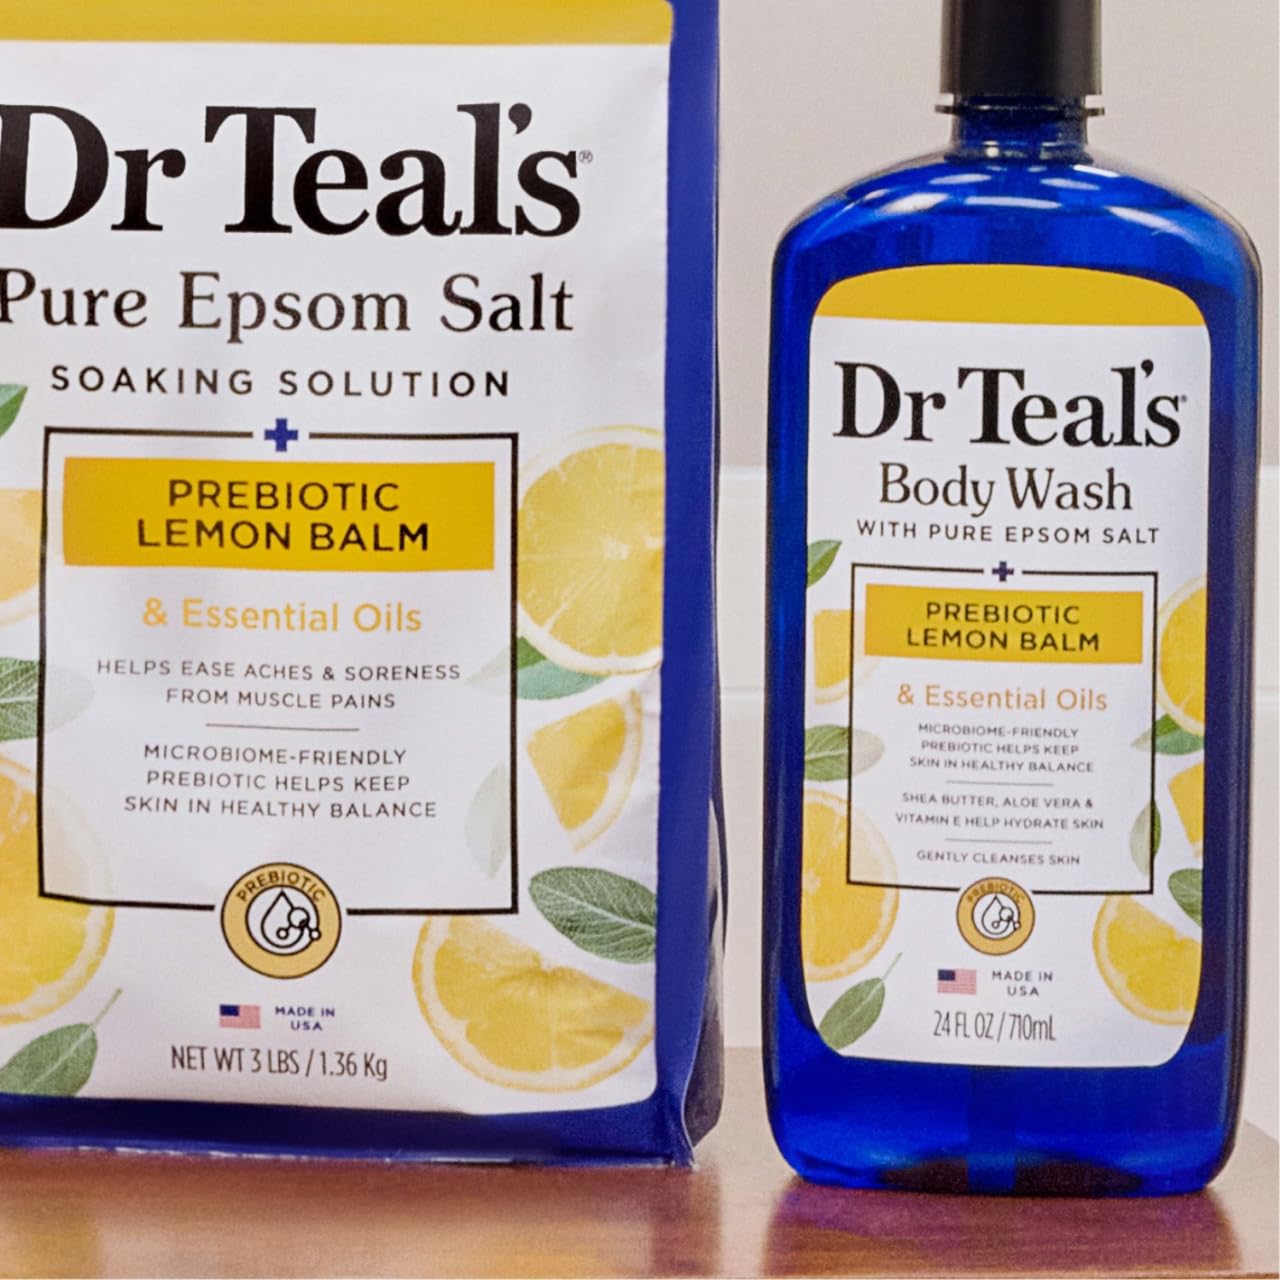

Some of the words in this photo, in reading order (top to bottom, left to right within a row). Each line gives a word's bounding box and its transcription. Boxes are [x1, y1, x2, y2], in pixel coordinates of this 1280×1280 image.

[204, 102, 581, 237] Teal's
[178, 270, 411, 344] Epsom
[440, 272, 574, 333] Salt
[51, 365, 253, 395] SOAKING
[279, 370, 509, 397] SOLUTION
[832, 361, 946, 442] Dr
[957, 359, 1181, 448] Teal's
[169, 479, 399, 512] PREBIOTIC
[879, 462, 995, 518] Body
[1005, 467, 1132, 511] Wash
[137, 518, 291, 550] LEMON
[310, 522, 428, 552] BALM
[857, 520, 917, 538] WITH
[929, 523, 992, 542] PURE
[1006, 526, 1089, 543] EPSOM
[1102, 527, 1159, 545] SALT
[142, 597, 167, 627] &
[183, 599, 339, 633] Essential
[353, 602, 421, 633] Oils
[927, 602, 1080, 625] PREBIOTIC
[907, 627, 1008, 649] LEMON
[1020, 632, 1099, 652] BALM
[97, 659, 171, 676] HELPS
[181, 661, 235, 678] EASE
[244, 664, 313, 681] ACHES
[322, 666, 336, 681] &
[344, 665, 461, 681] SORENESS
[166, 688, 228, 705] FROM
[238, 691, 321, 709] MUSCLE
[332, 693, 395, 709] PAINS
[897, 684, 914, 705] &
[925, 685, 1045, 709] Essential
[1056, 689, 1107, 711] Oils
[918, 723, 1079, 738] MICROBIOME-FRIENDLY
[144, 744, 407, 765] MICROBIOME-FRIENDLY
[921, 741, 993, 753] PREBIOTIC
[996, 744, 1040, 755] HELPS
[1044, 745, 1079, 755] KEEP
[910, 757, 940, 768] SKIN
[944, 759, 957, 769] IN
[961, 759, 1024, 771] HEALTHY
[1028, 762, 1094, 773] BALANCE
[147, 770, 267, 790] PREBIOTIC
[275, 776, 344, 792] HELPS
[354, 776, 410, 792] KEEP
[124, 796, 178, 813] SKIN
[189, 799, 210, 814] IN
[221, 800, 320, 818] HEALTHY
[331, 802, 437, 819] BALANCE
[902, 792, 937, 804] SHEA
[942, 794, 999, 808] BUTTER,
[1003, 797, 1039, 808] ALOE
[1044, 797, 1080, 808] VERA
[1084, 798, 1093, 809] &
[896, 812, 949, 825] VITAMIN
[953, 815, 961, 826] E
[963, 816, 1000, 828] HELP
[1004, 818, 1068, 829] HYDRATE
[1073, 819, 1104, 829] SKIN
[917, 850, 969, 862] GENTLY
[972, 852, 1045, 864] CLEANSES
[1049, 854, 1080, 865] SKIN
[236, 870, 326, 903] PREBIOTIC
[992, 971, 1032, 981] MADE
[1039, 971, 1053, 981] IN
[1007, 986, 1039, 996] USA
[275, 1006, 315, 1017] MADE
[321, 1007, 335, 1018] IN
[291, 1021, 323, 1031] USA
[933, 1010, 951, 1036] 24
[955, 1011, 970, 1038] FL
[974, 1013, 994, 1039] OZ
[997, 1011, 1005, 1042] /
[1009, 1013, 1056, 1041] 710mL
[171, 1045, 207, 1071] NET
[214, 1047, 245, 1072] WT
[251, 1049, 261, 1073] 3
[268, 1049, 300, 1074] LBS
[305, 1049, 315, 1078] /
[320, 1051, 358, 1077] 1.36
[364, 1053, 388, 1082] Kg
